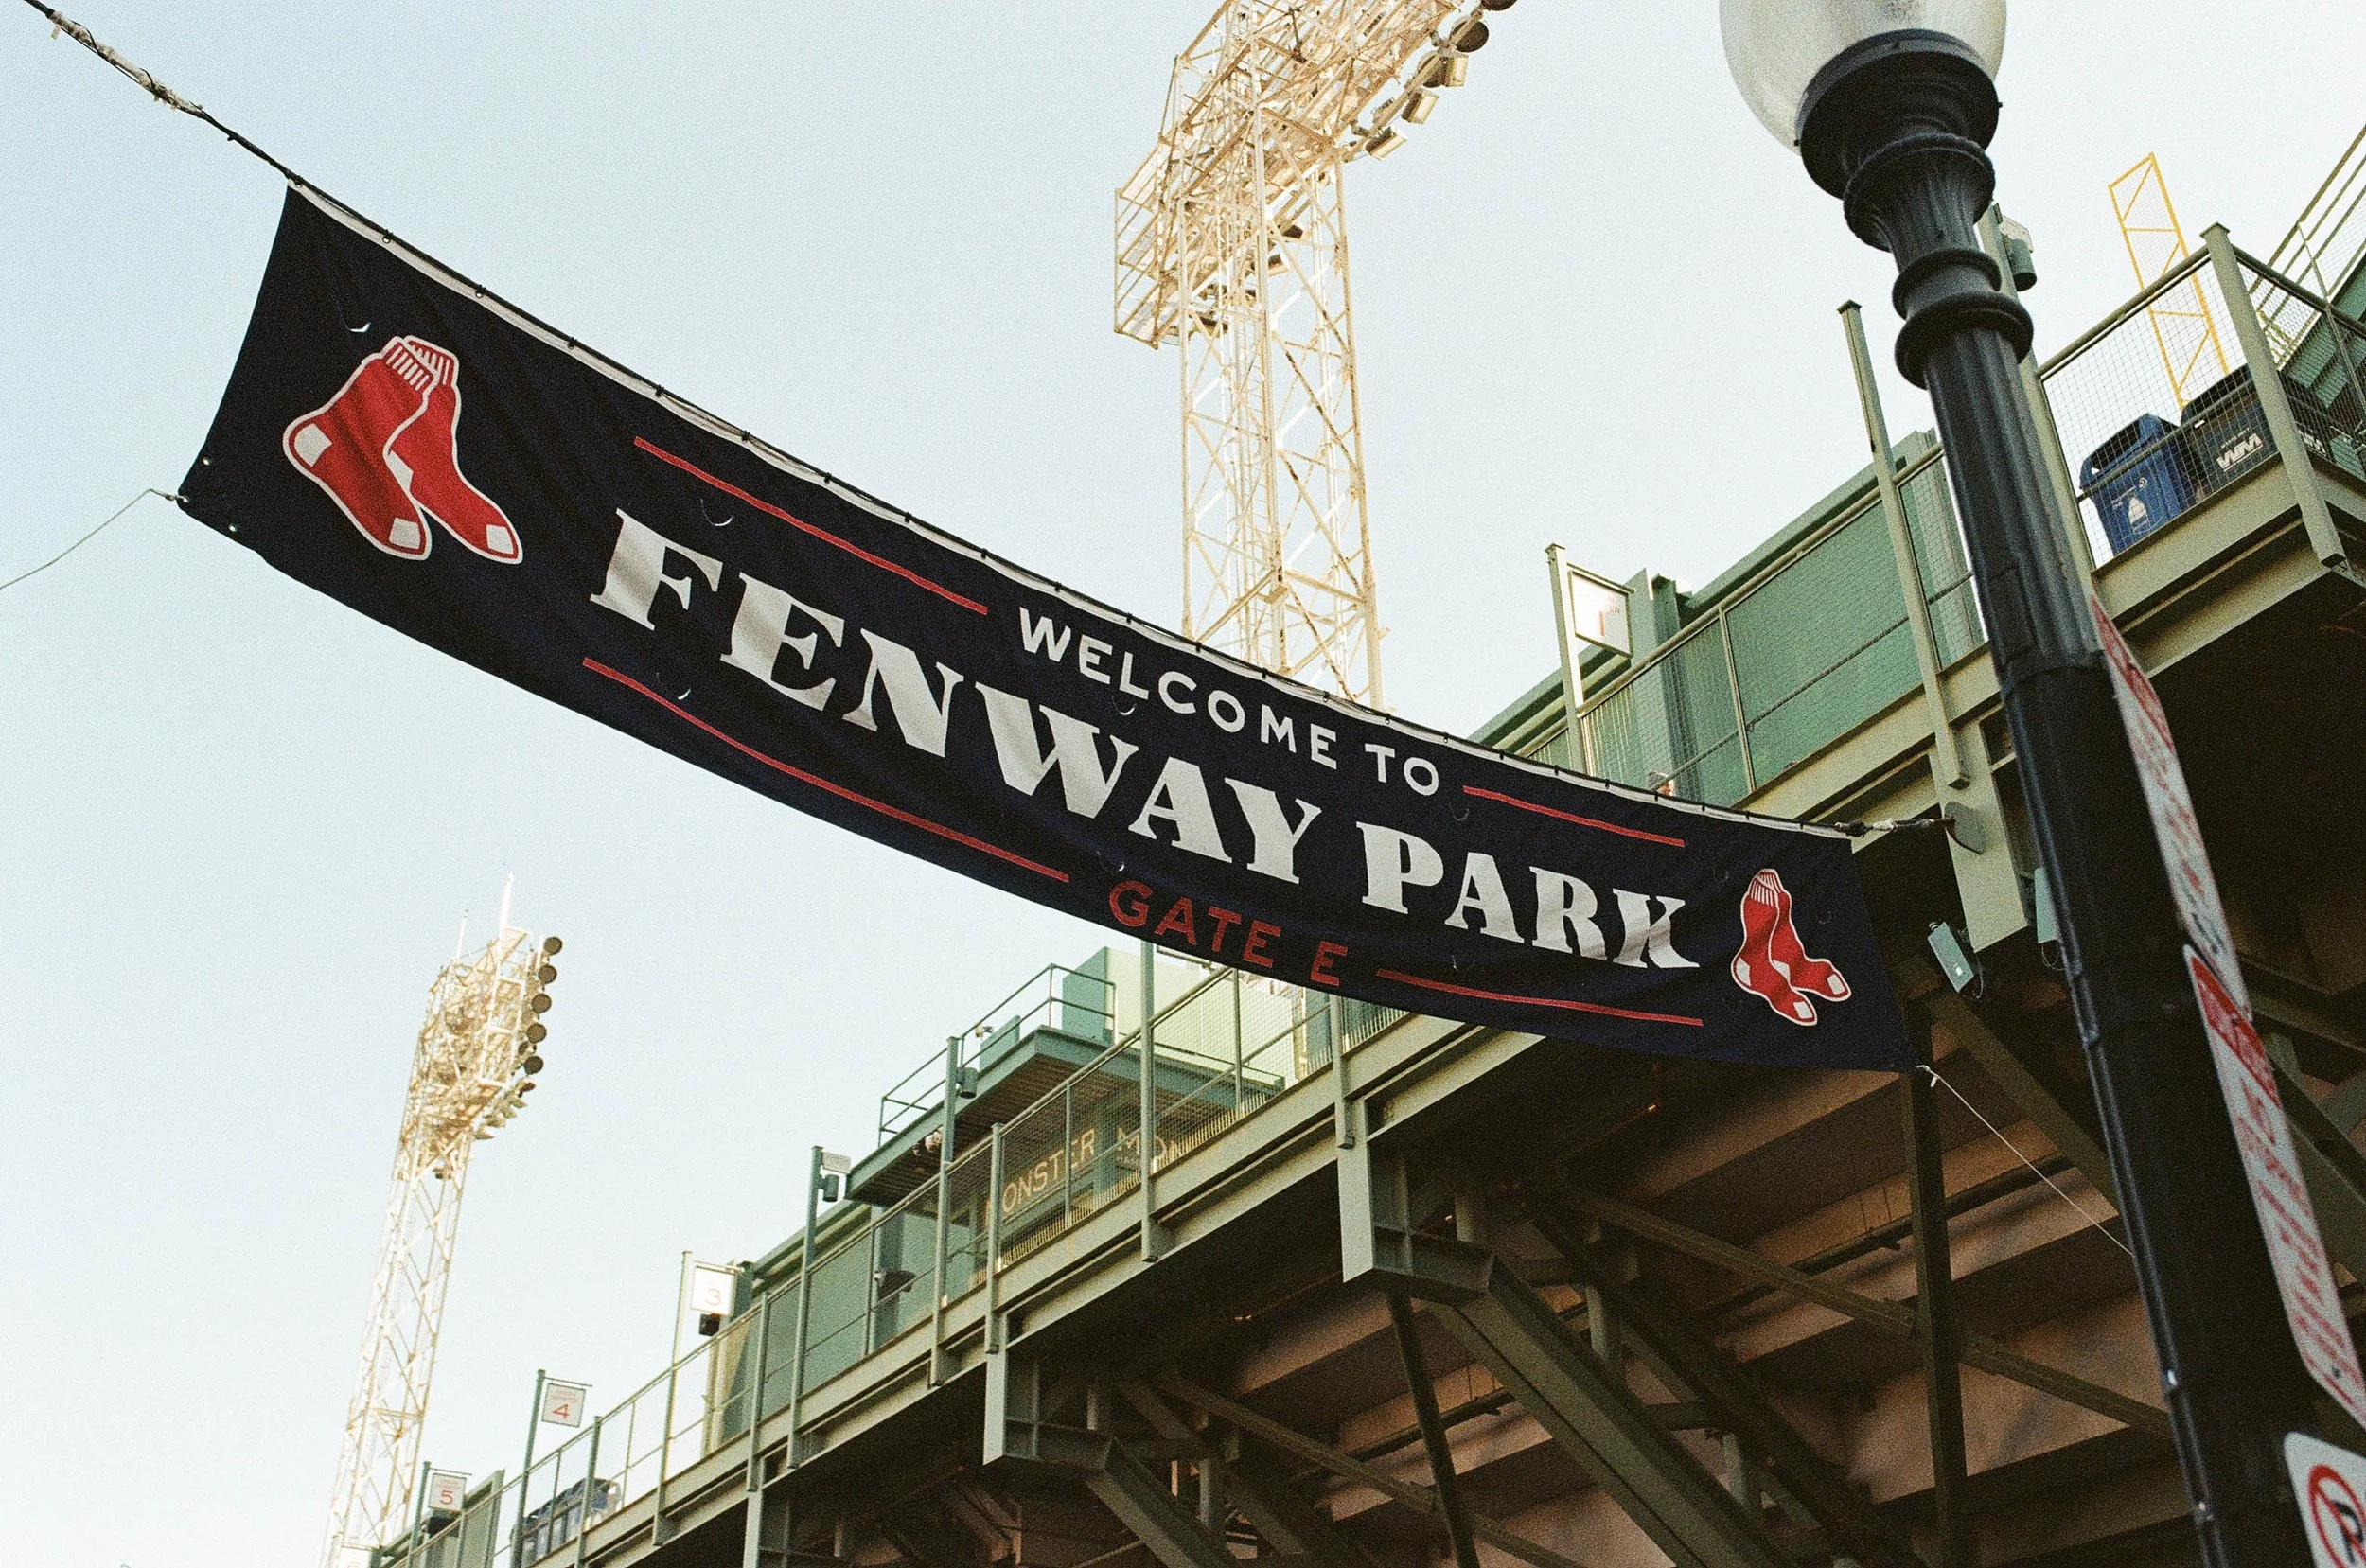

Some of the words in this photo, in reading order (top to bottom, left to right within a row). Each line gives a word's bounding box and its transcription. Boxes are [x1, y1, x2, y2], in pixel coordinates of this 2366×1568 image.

[1020, 608, 1337, 769] WELCOME
[1365, 743, 1439, 797] TO
[590, 507, 1322, 885] FENWAY
[1356, 820, 1701, 969] PARK
[1109, 881, 1281, 967] GATE
[1310, 941, 1348, 986] E
[703, 1288, 721, 1306] 3
[552, 1403, 570, 1419] 4
[439, 1489, 454, 1506] 5
